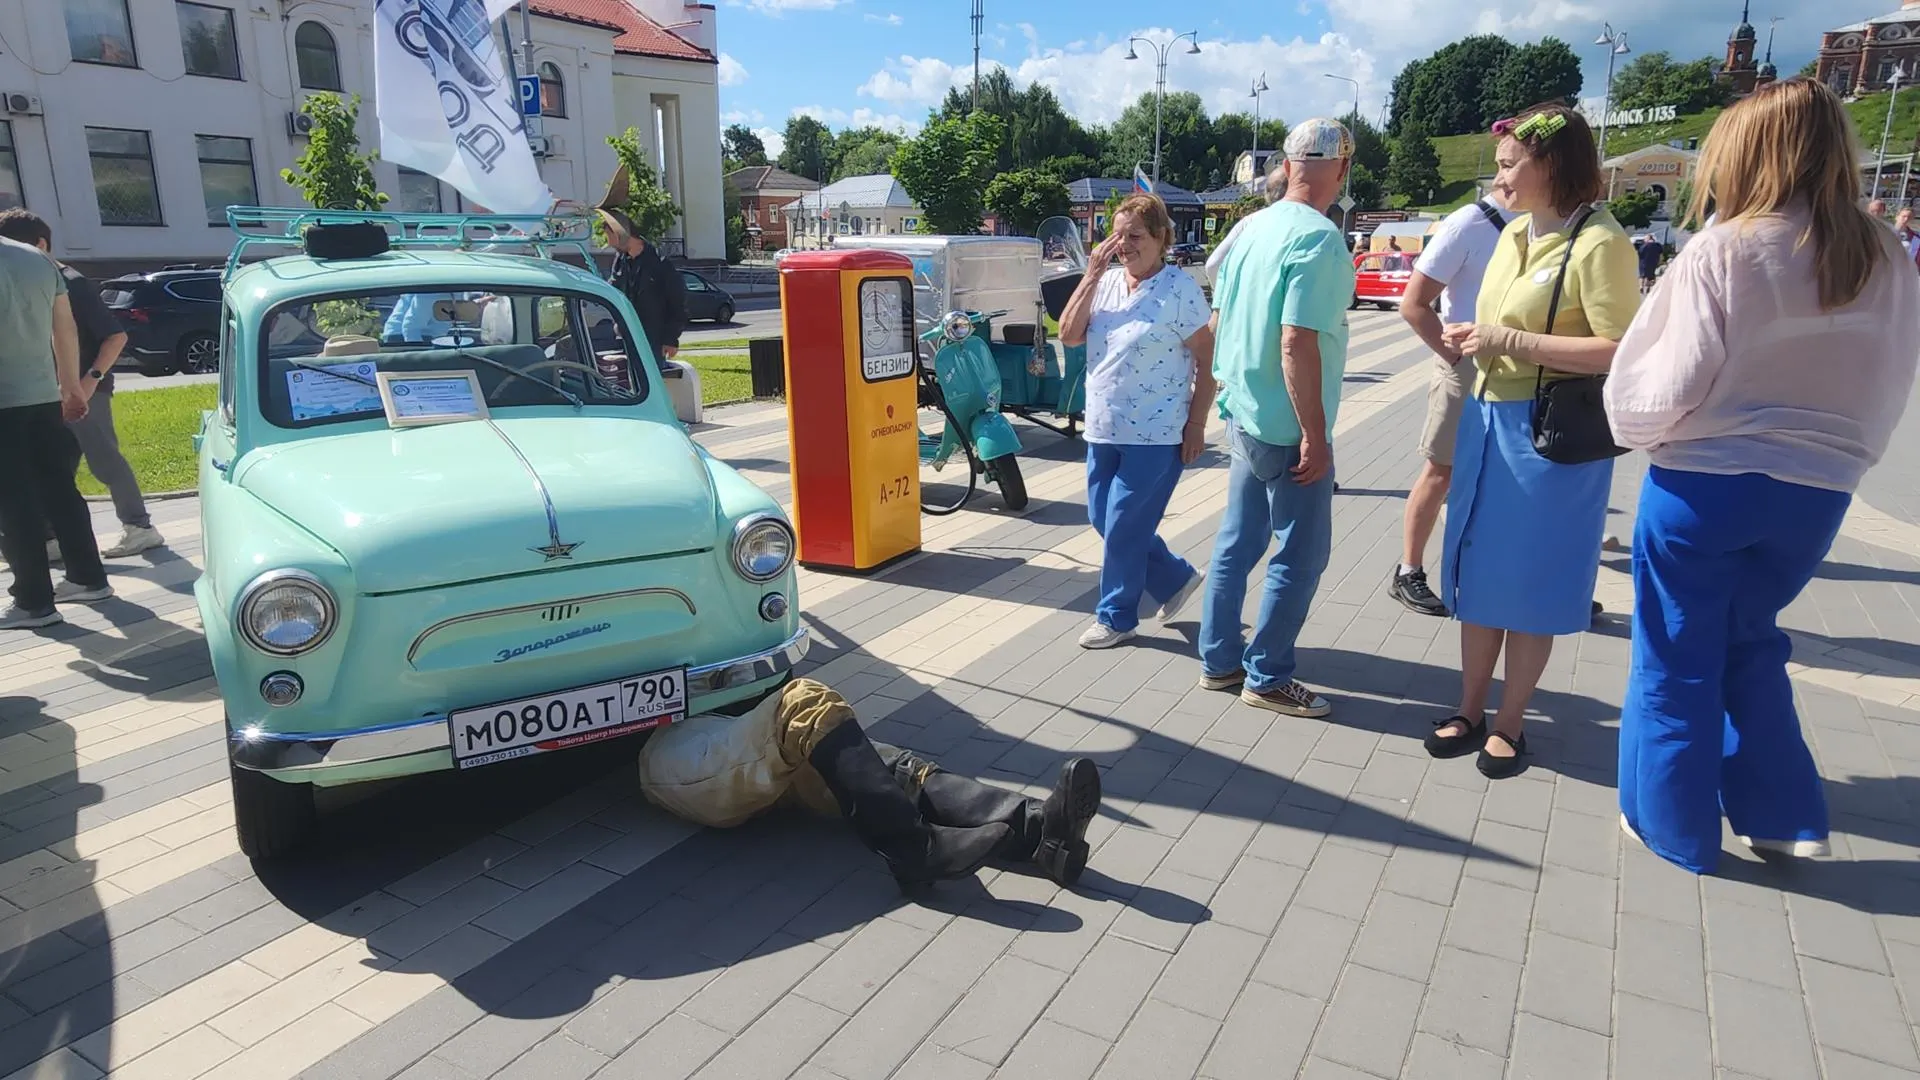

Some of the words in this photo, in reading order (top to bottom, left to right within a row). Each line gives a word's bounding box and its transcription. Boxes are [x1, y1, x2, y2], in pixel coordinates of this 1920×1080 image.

[519, 82, 534, 101] P
[1648, 105, 1677, 122] 1135
[867, 357, 909, 375] БЕНЗИН
[880, 475, 910, 504] А-72
[465, 696, 616, 751] М080АТ
[623, 675, 675, 708] 790
[637, 703, 663, 716] RUS
[557, 735, 583, 747] Тойота
[584, 730, 608, 744] Центр
[464, 755, 489, 767] (495)
